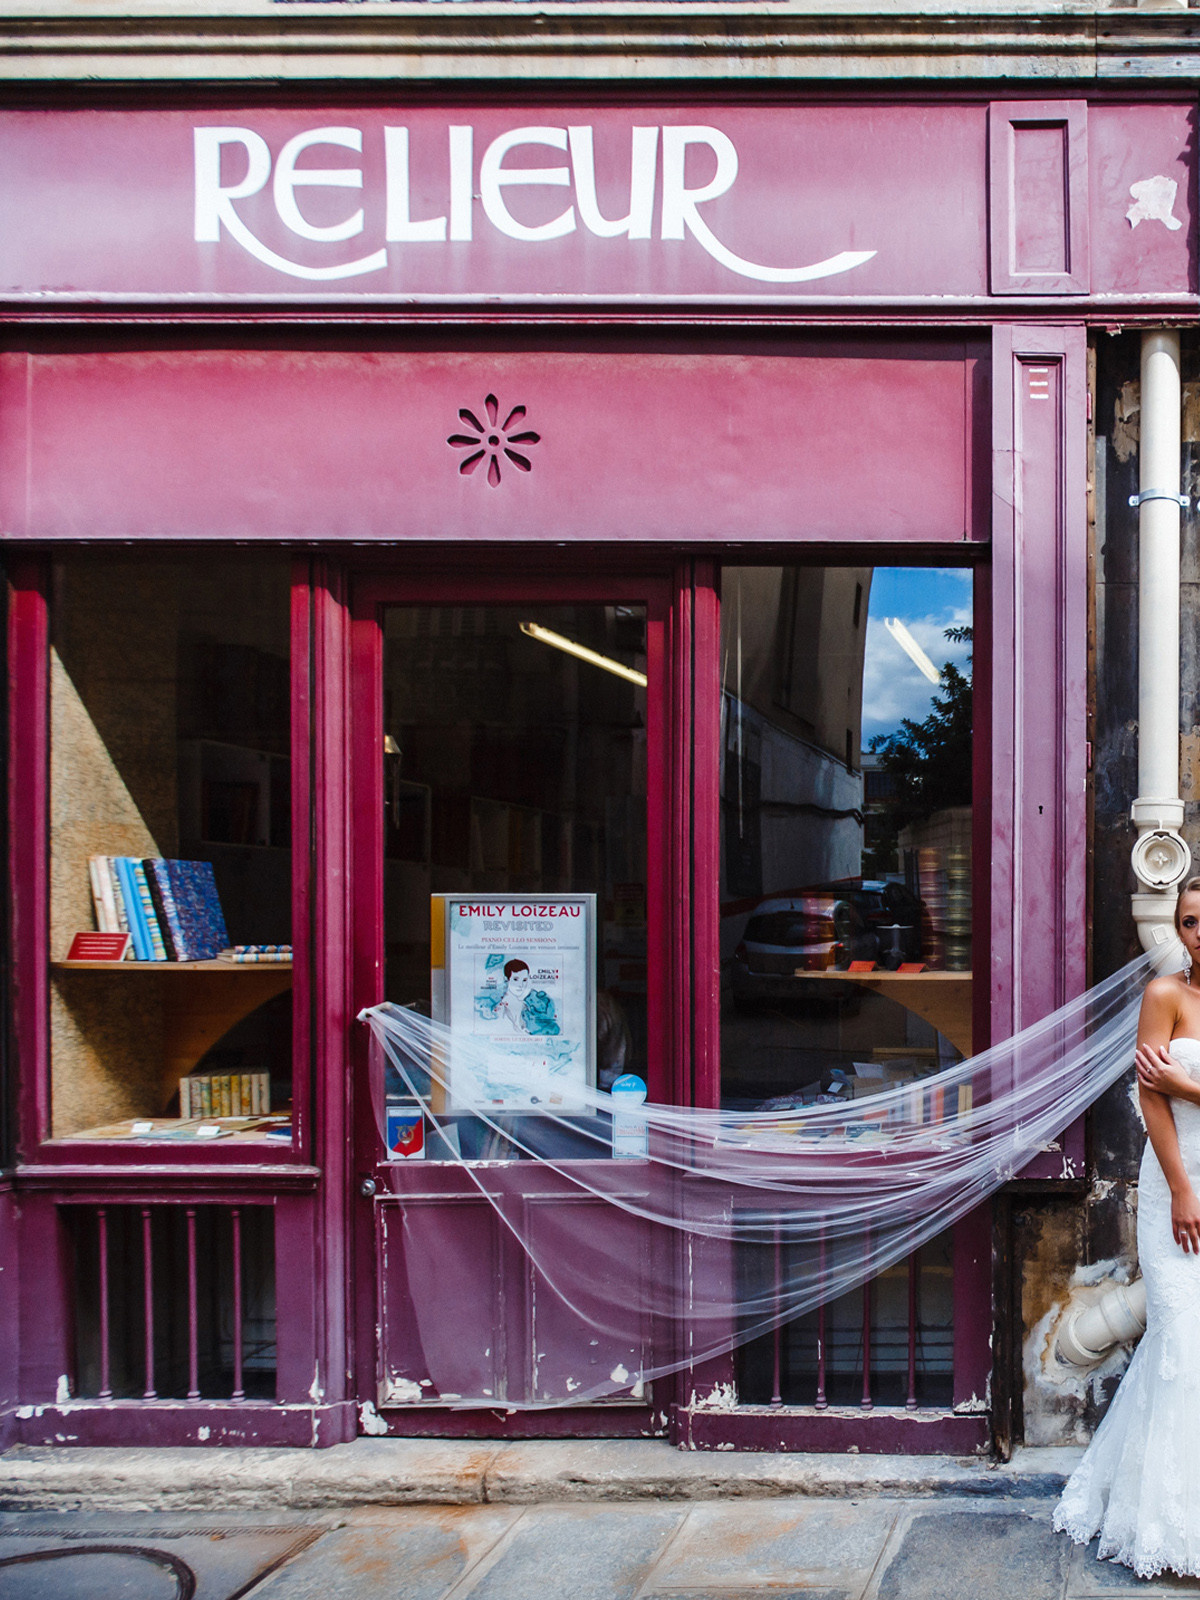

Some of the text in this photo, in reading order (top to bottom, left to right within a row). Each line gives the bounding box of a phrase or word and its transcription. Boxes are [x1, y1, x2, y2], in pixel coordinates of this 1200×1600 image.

[192, 124, 878, 283] RELIEUR
[459, 905, 506, 917] EMILY
[483, 920, 554, 932] REVISITED
